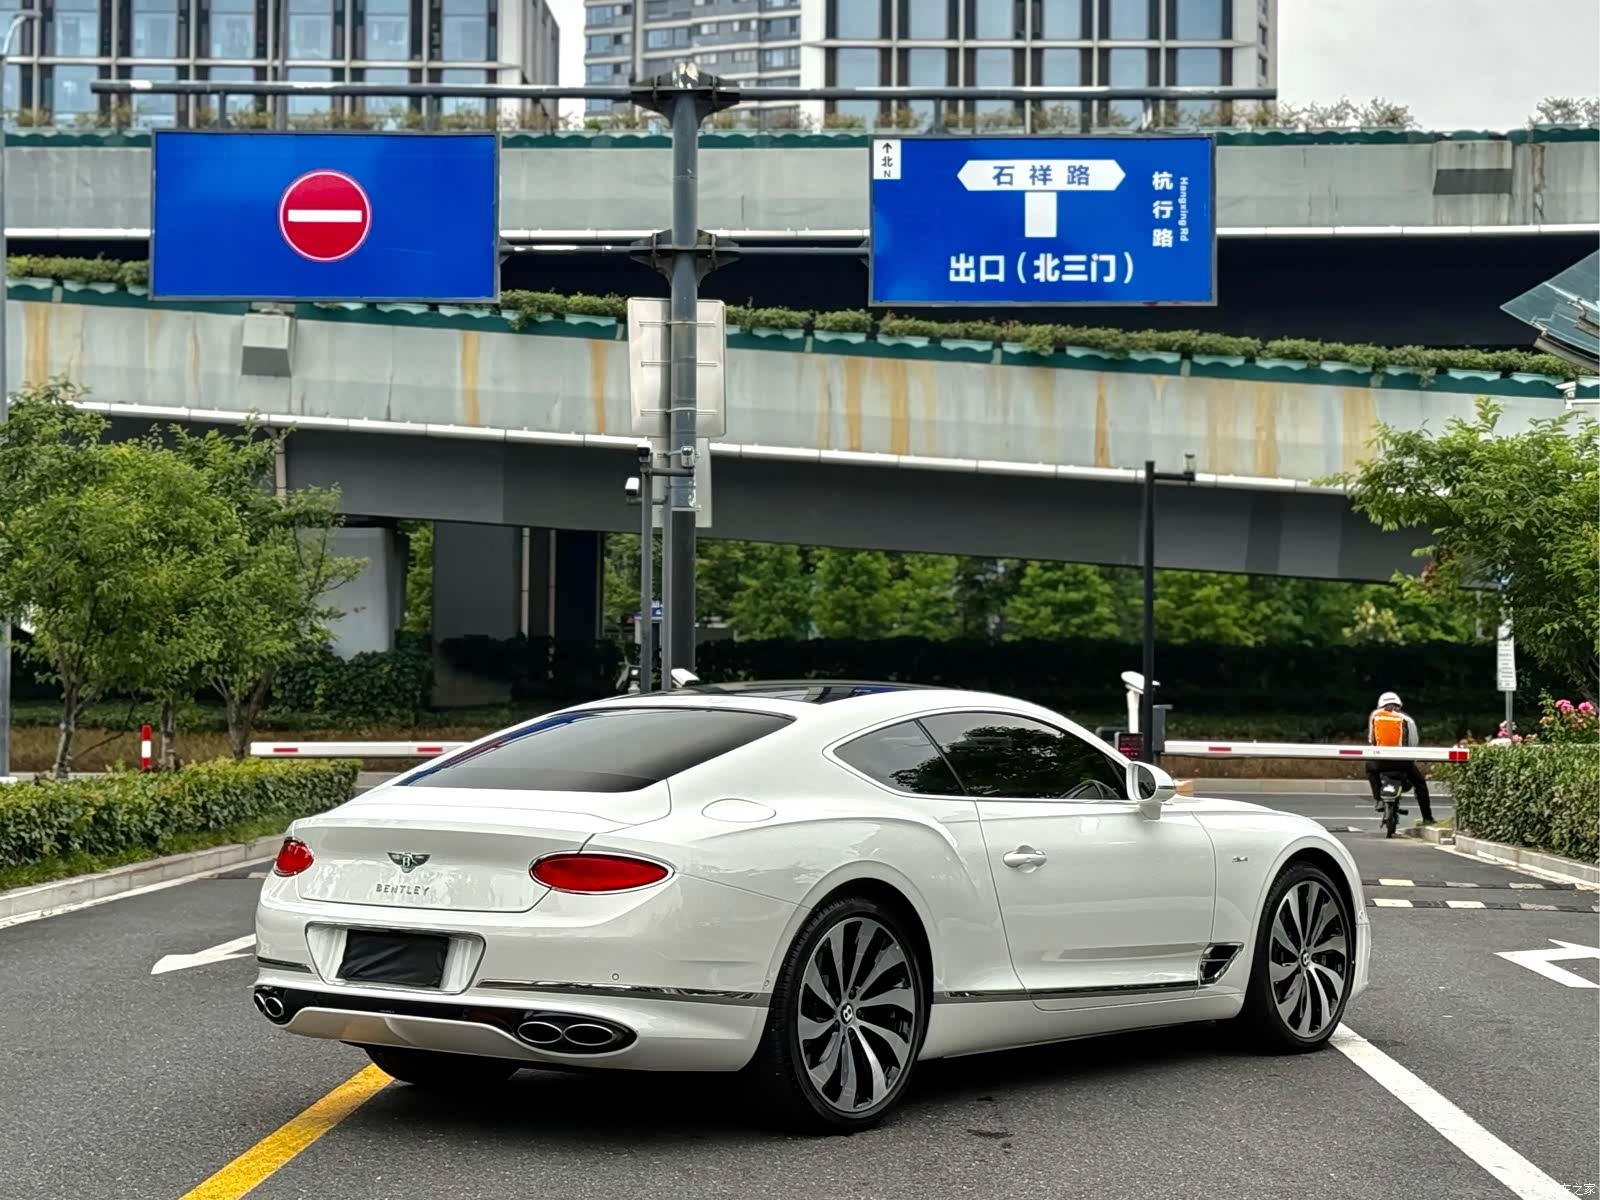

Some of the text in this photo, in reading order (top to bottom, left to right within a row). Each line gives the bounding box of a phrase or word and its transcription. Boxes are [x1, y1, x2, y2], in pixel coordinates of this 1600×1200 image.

[881, 155, 893, 168] 北
[883, 169, 891, 178] N
[992, 164, 1090, 186] 石祥路
[1152, 171, 1173, 248] 杭行路
[1178, 176, 1189, 242] Hangxing Rd
[949, 252, 1134, 284] 出口（北三门）
[376, 883, 430, 896] BENTLEY
